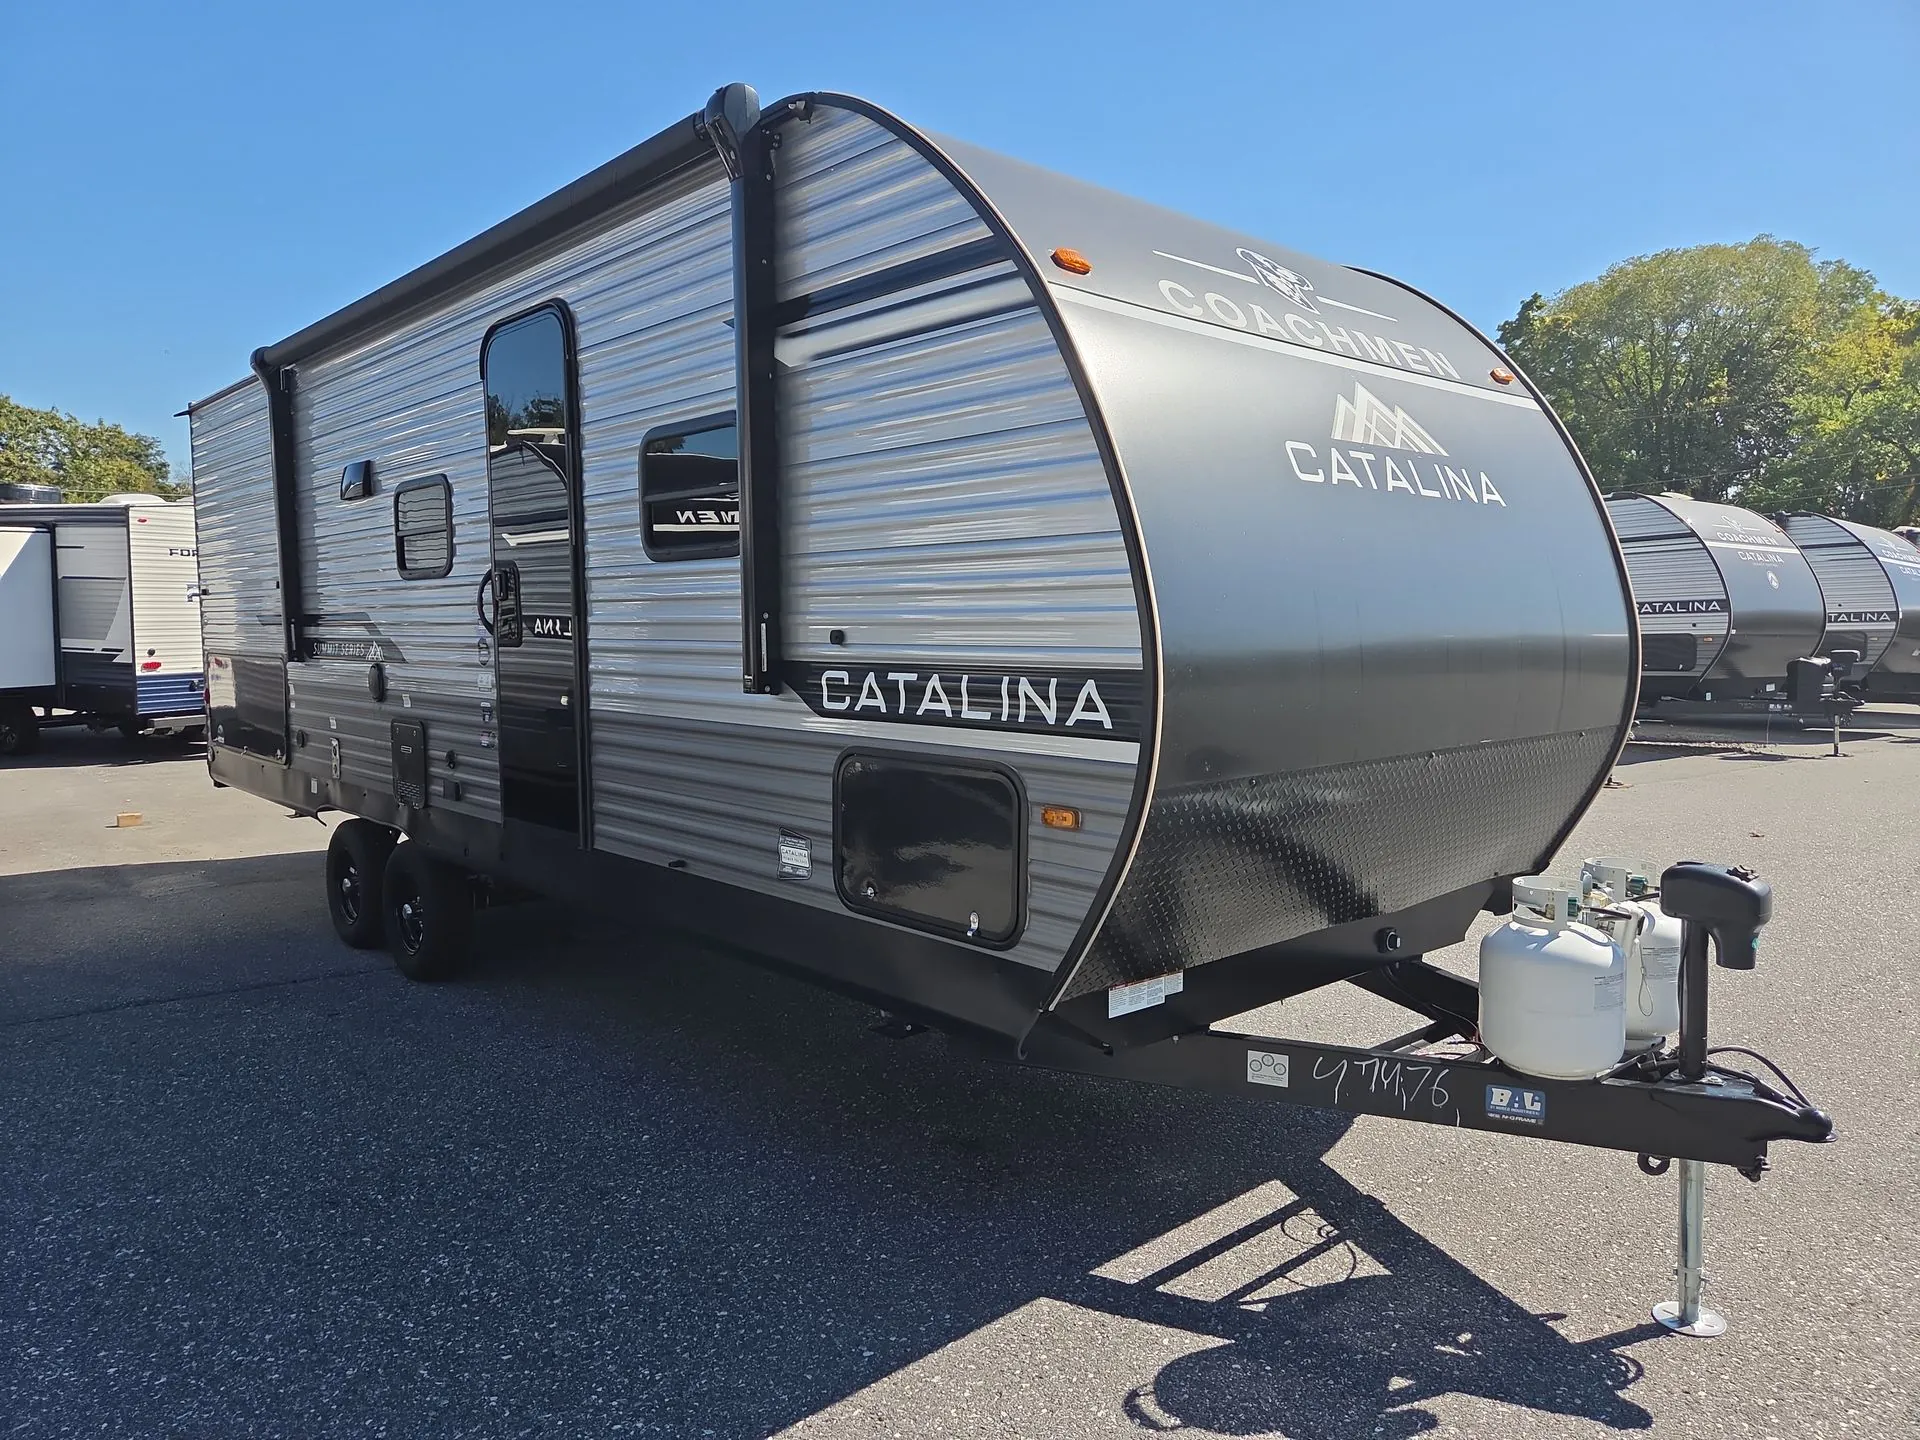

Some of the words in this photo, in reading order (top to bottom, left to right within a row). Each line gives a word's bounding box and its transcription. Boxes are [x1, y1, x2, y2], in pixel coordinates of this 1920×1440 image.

[1158, 279, 1461, 379] COACHMEN
[1285, 440, 1507, 507] CATALINA
[1716, 531, 1779, 546] COACHMEN
[1737, 551, 1784, 563] CATALINA
[1828, 612, 1891, 622] TALINA
[313, 642, 339, 656] SUMMIT
[341, 643, 365, 656] SERIES
[821, 670, 1112, 729] CATALINA
